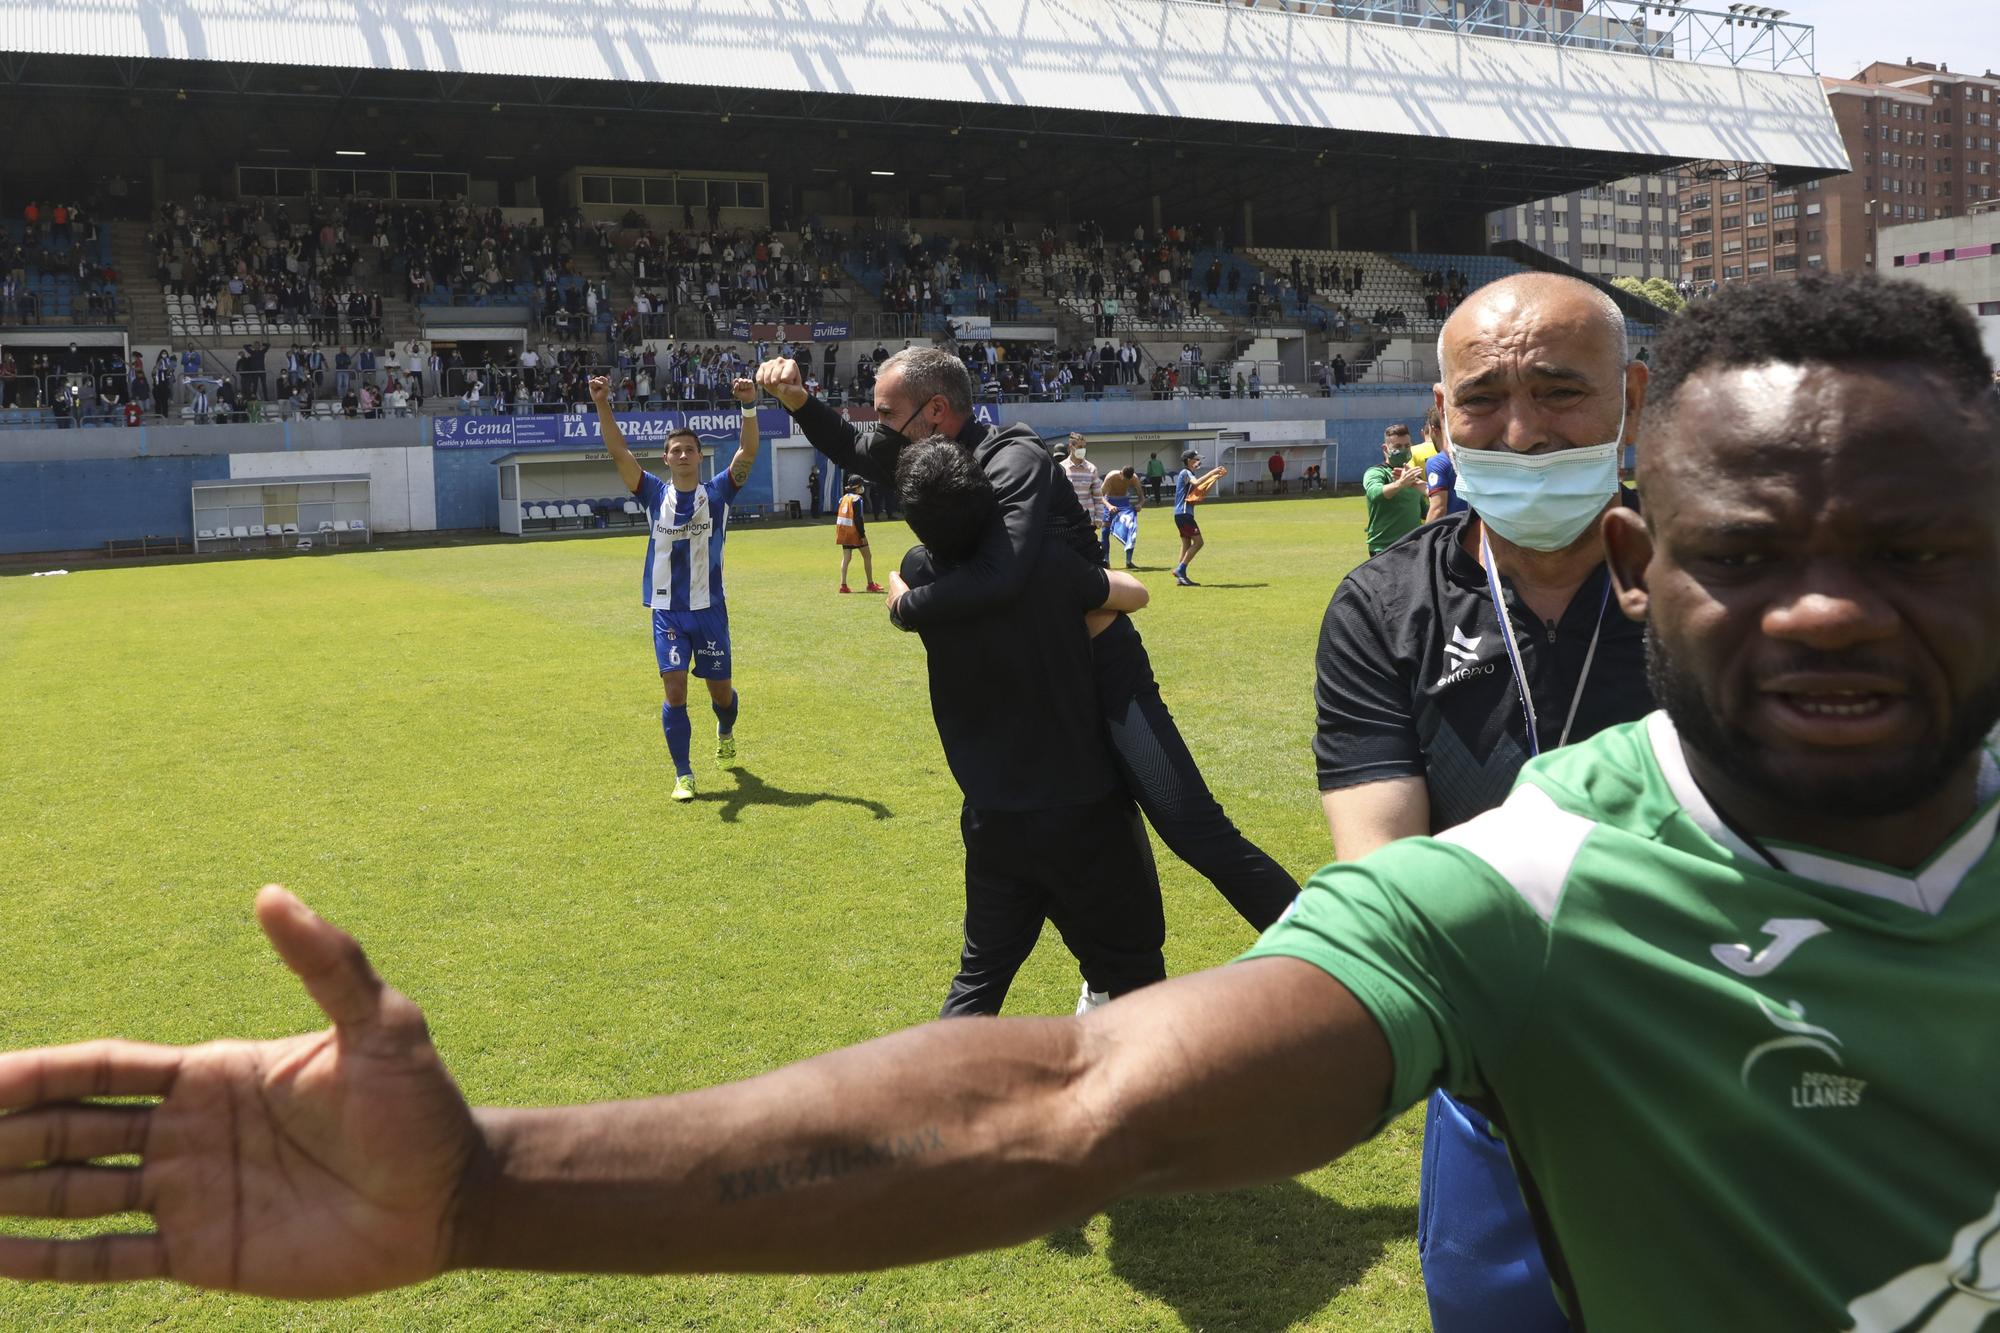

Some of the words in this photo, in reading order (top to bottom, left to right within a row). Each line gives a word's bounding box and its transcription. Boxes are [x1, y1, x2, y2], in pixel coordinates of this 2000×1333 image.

[563, 414, 582, 422] BAR
[464, 420, 512, 436] Gema
[564, 422, 587, 437] LA
[592, 420, 675, 436] TRRAZA
[1134, 432, 1161, 440] Visitante
[484, 437, 512, 445] Ambiente
[669, 645, 681, 666] 6
[1791, 1085, 1861, 1109] LLANES
